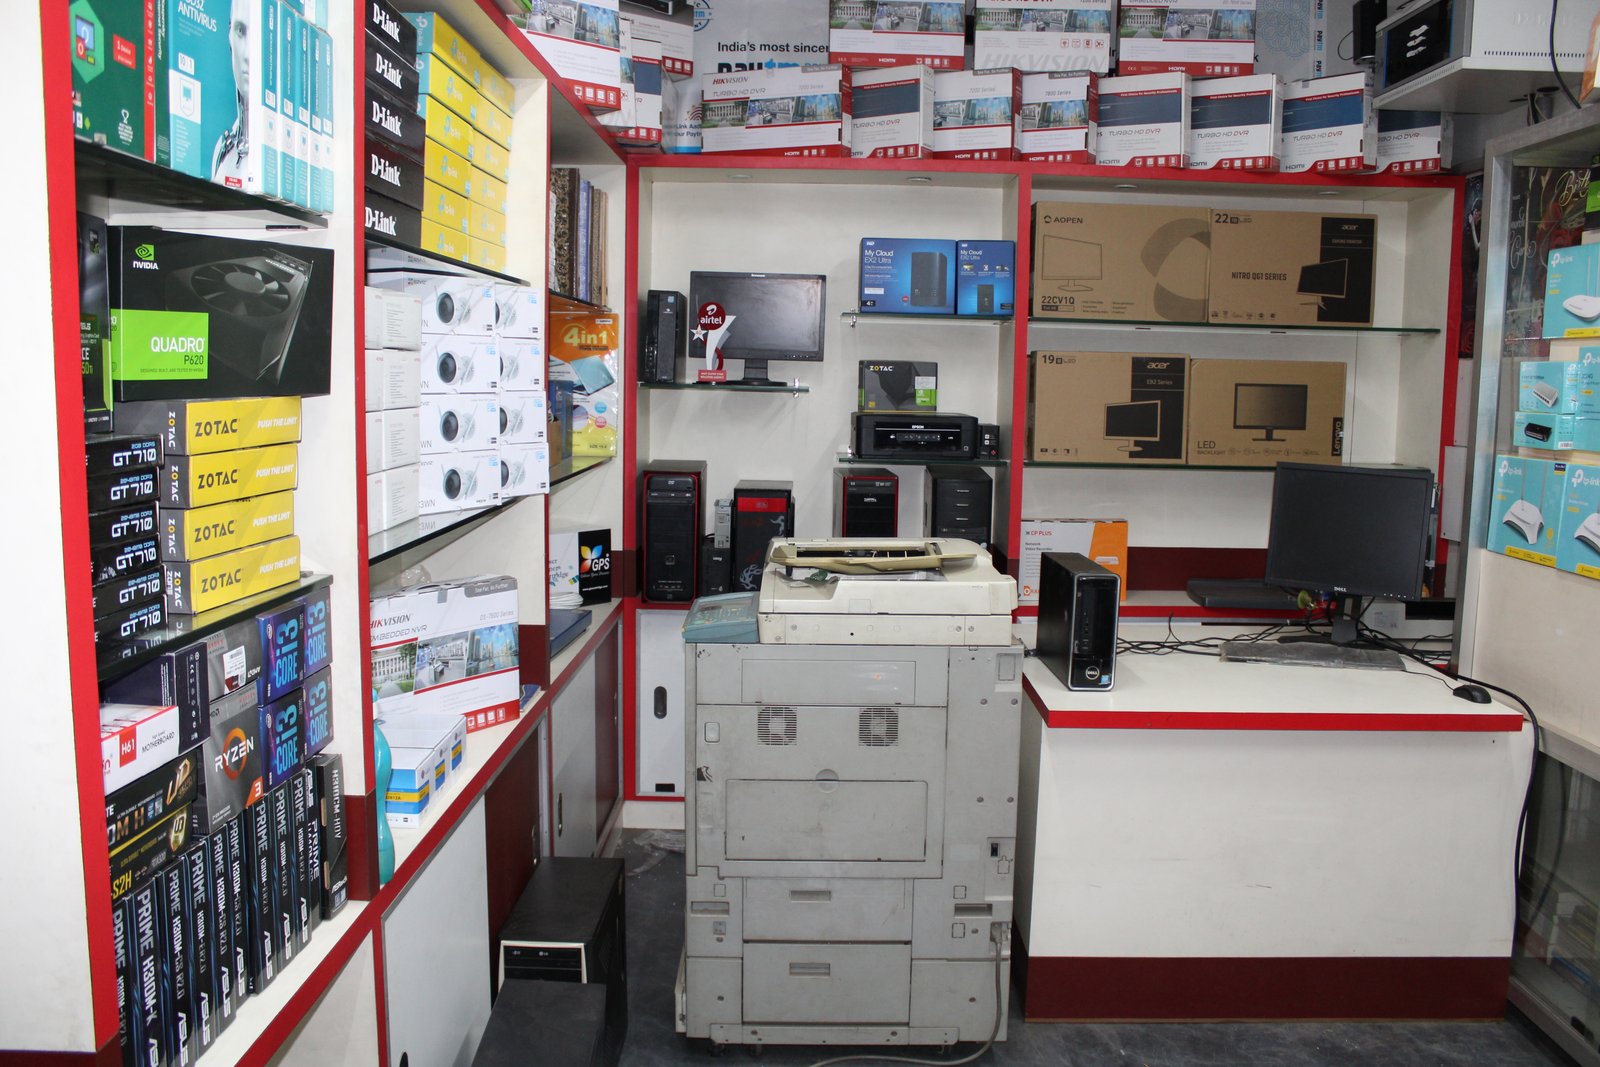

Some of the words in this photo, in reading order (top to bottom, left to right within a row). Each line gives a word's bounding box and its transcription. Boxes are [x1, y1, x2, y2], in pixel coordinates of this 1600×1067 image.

[177, 4, 217, 32] ANTIVIRUS
[372, 2, 400, 42] D-Link
[718, 42, 756, 52] India's
[760, 42, 790, 52] most
[376, 53, 402, 89] D-Link
[712, 76, 748, 84] HIKVISION
[372, 101, 402, 137] D-Link
[853, 120, 875, 128] TURBO
[371, 154, 400, 186] D-Link
[364, 206, 396, 236] D-Link
[1215, 213, 1228, 223] 22
[133, 261, 158, 270] NVIDIA
[1041, 296, 1075, 304] 22CV1Q
[700, 316, 722, 324] airtel
[151, 336, 204, 353] QUADRO
[184, 355, 204, 365] P620
[1042, 354, 1054, 364] 19
[195, 418, 239, 437] ZOTAC
[113, 450, 134, 467] GT
[134, 449, 156, 462] 710
[1197, 441, 1216, 449] LED
[111, 484, 131, 501] GT
[131, 481, 153, 497] 710
[198, 469, 240, 489] ZOTAC
[111, 521, 132, 538] GT
[131, 517, 153, 533] 710
[194, 520, 235, 542] ZOTAC
[116, 554, 136, 570] GT
[134, 547, 157, 564] 710
[592, 557, 610, 571] GPS
[119, 586, 137, 604] GT
[138, 579, 160, 596] 710
[201, 568, 243, 594] ZOTAC
[121, 619, 138, 636] GT
[140, 610, 160, 628] 710
[307, 600, 326, 636] i3
[412, 625, 427, 633] NVR
[276, 618, 299, 657] i3
[307, 632, 326, 665] CORE
[275, 654, 298, 688] CORE
[309, 680, 327, 716] i3
[276, 704, 298, 744] i3
[310, 711, 328, 746] CORE
[121, 738, 136, 755] H61
[142, 732, 175, 753] MOTHERBOARD
[215, 736, 254, 772] RYZEN
[276, 736, 298, 775] CORE
[274, 789, 287, 840] PRIME
[293, 778, 305, 826] PRIME
[229, 819, 240, 862] PRIME
[255, 803, 268, 855] PRIME
[213, 834, 224, 877] PRIME
[312, 820, 320, 882] PRIME
[169, 870, 180, 917] PRIME
[191, 849, 205, 910] PRIME
[232, 861, 242, 911] H310M-CS
[217, 877, 227, 929] H310M-CS
[137, 889, 154, 956] PRIME
[234, 914, 243, 936] R2.0
[283, 912, 292, 960] ASUS
[300, 897, 309, 943] ASUS
[173, 916, 183, 972] H310M-CS
[219, 931, 228, 955] R2.0
[263, 931, 273, 979] ASUS
[176, 974, 185, 1000] R2.0
[236, 947, 246, 997] ASUS
[221, 966, 231, 1018] ASUS
[200, 992, 211, 1046] ASUS
[178, 1012, 189, 1067] ASUS
